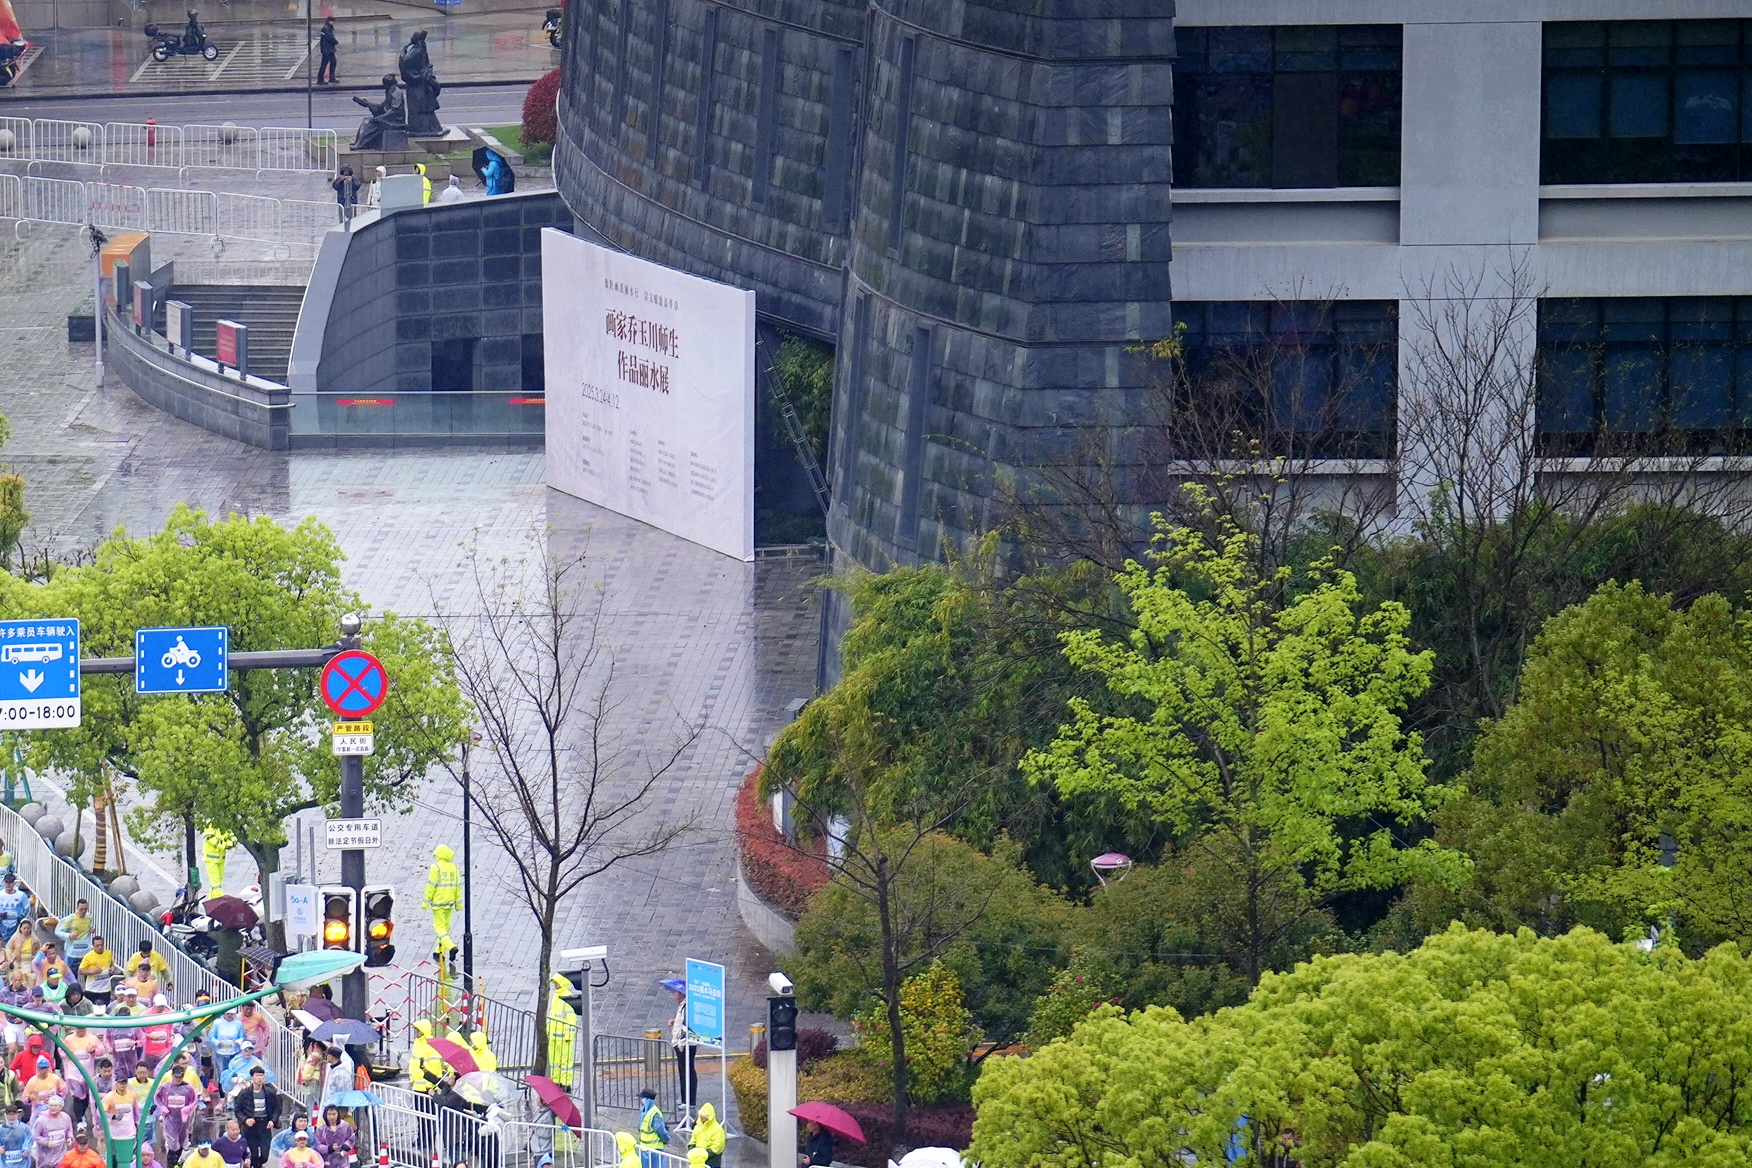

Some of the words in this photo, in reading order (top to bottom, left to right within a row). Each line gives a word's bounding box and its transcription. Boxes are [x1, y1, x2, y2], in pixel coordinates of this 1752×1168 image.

[605, 308, 679, 358] 画家乔玉川师生
[617, 350, 669, 395] 作品丽水展
[336, 724, 370, 732] 严管路段
[340, 737, 366, 745] 人民街
[328, 823, 379, 832] 公交专用车道
[328, 836, 379, 845] 除法定节假日外
